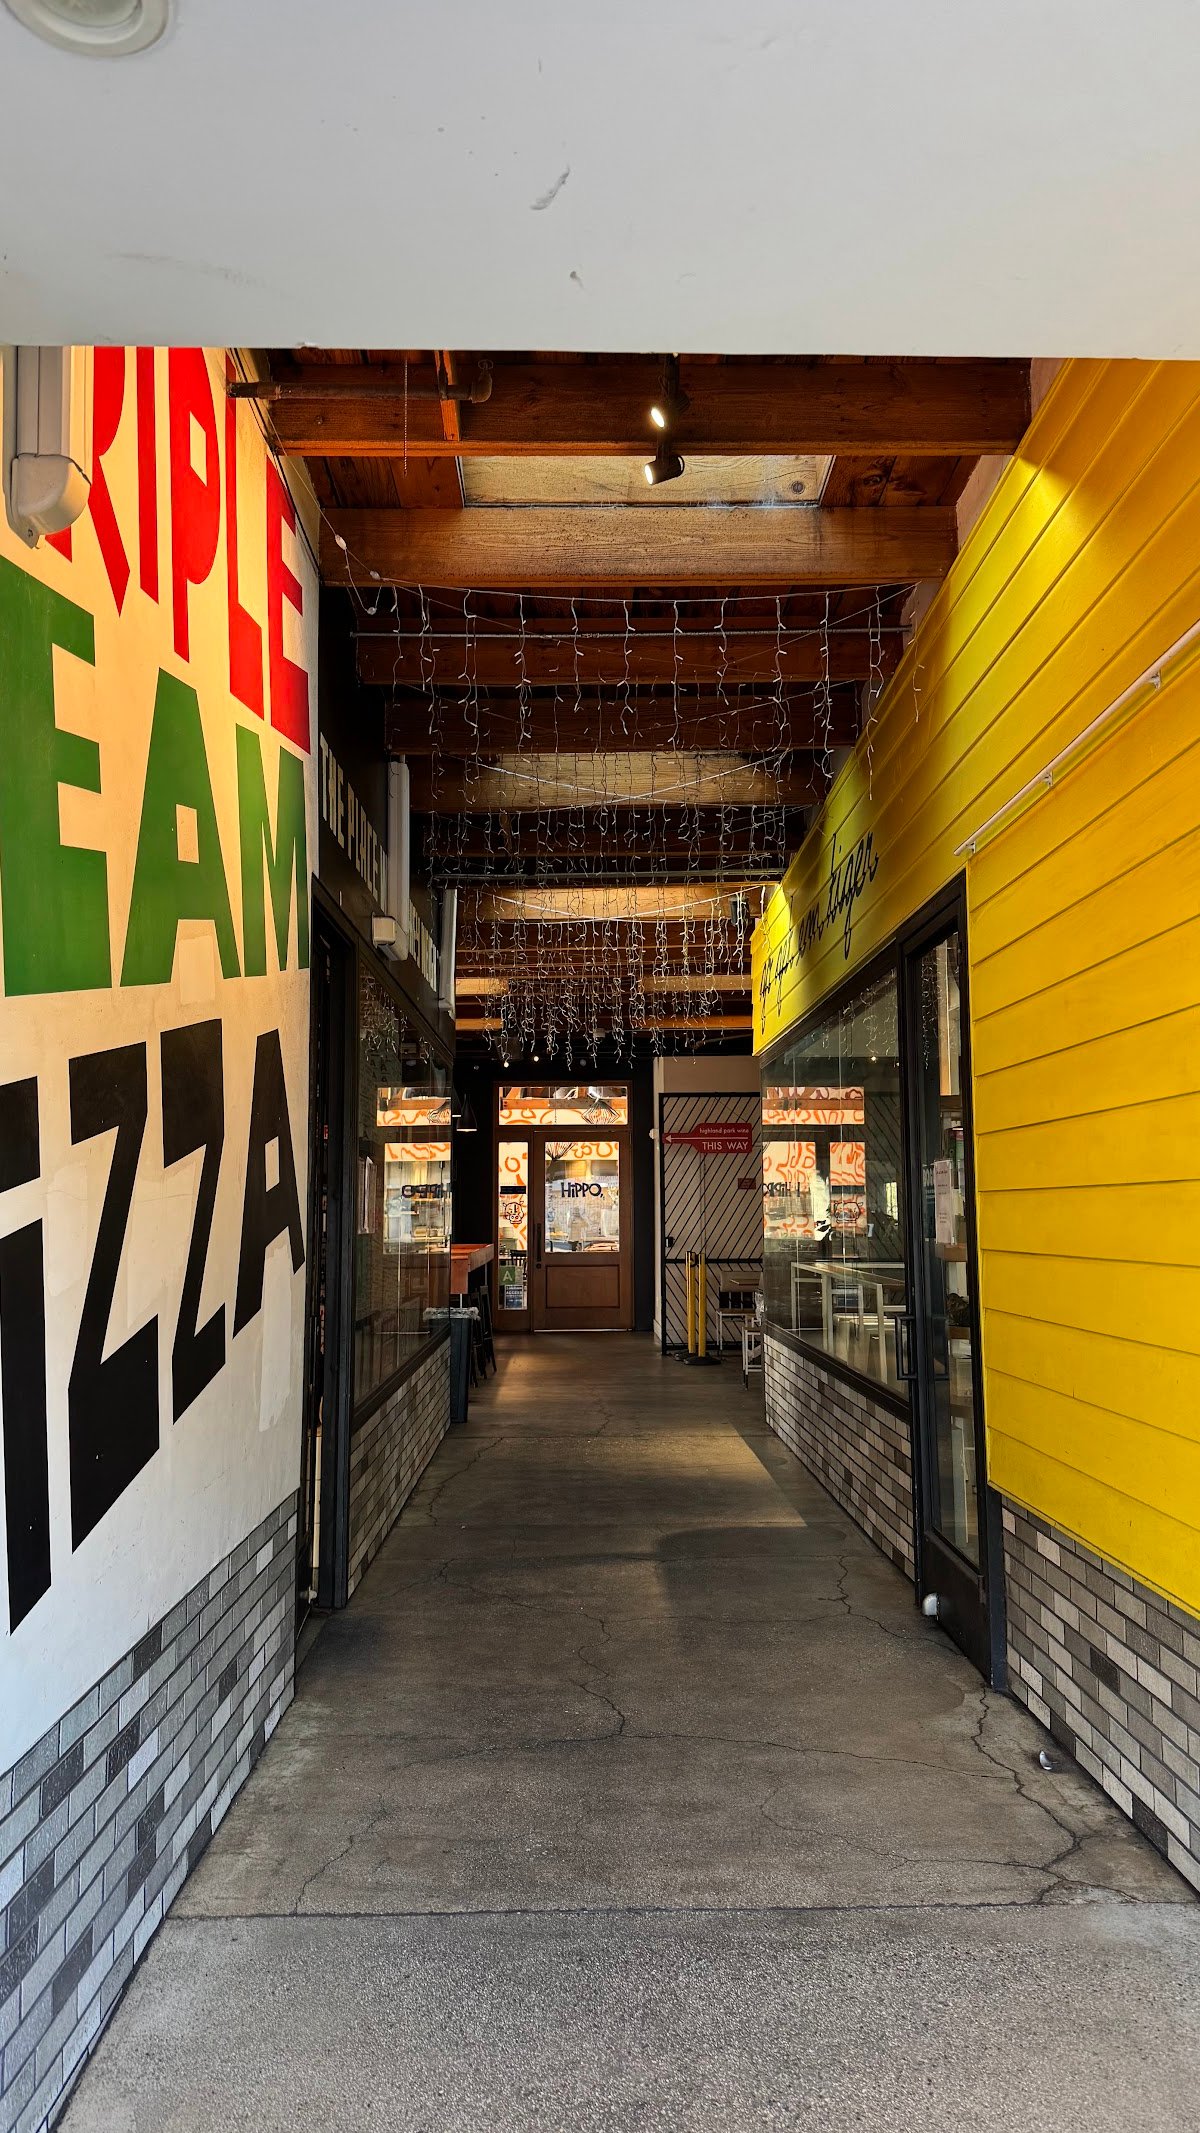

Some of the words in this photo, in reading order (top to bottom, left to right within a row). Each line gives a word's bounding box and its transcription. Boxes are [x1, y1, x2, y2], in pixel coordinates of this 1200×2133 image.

[320, 732, 345, 849] THE
[347, 781, 378, 902] PLACE
[826, 831, 880, 961] tiger
[700, 1127, 723, 1135] highland
[723, 1127, 736, 1135] park
[702, 1141, 723, 1151] THIS
[726, 1141, 749, 1151] WAY
[502, 1270, 513, 1282] A
